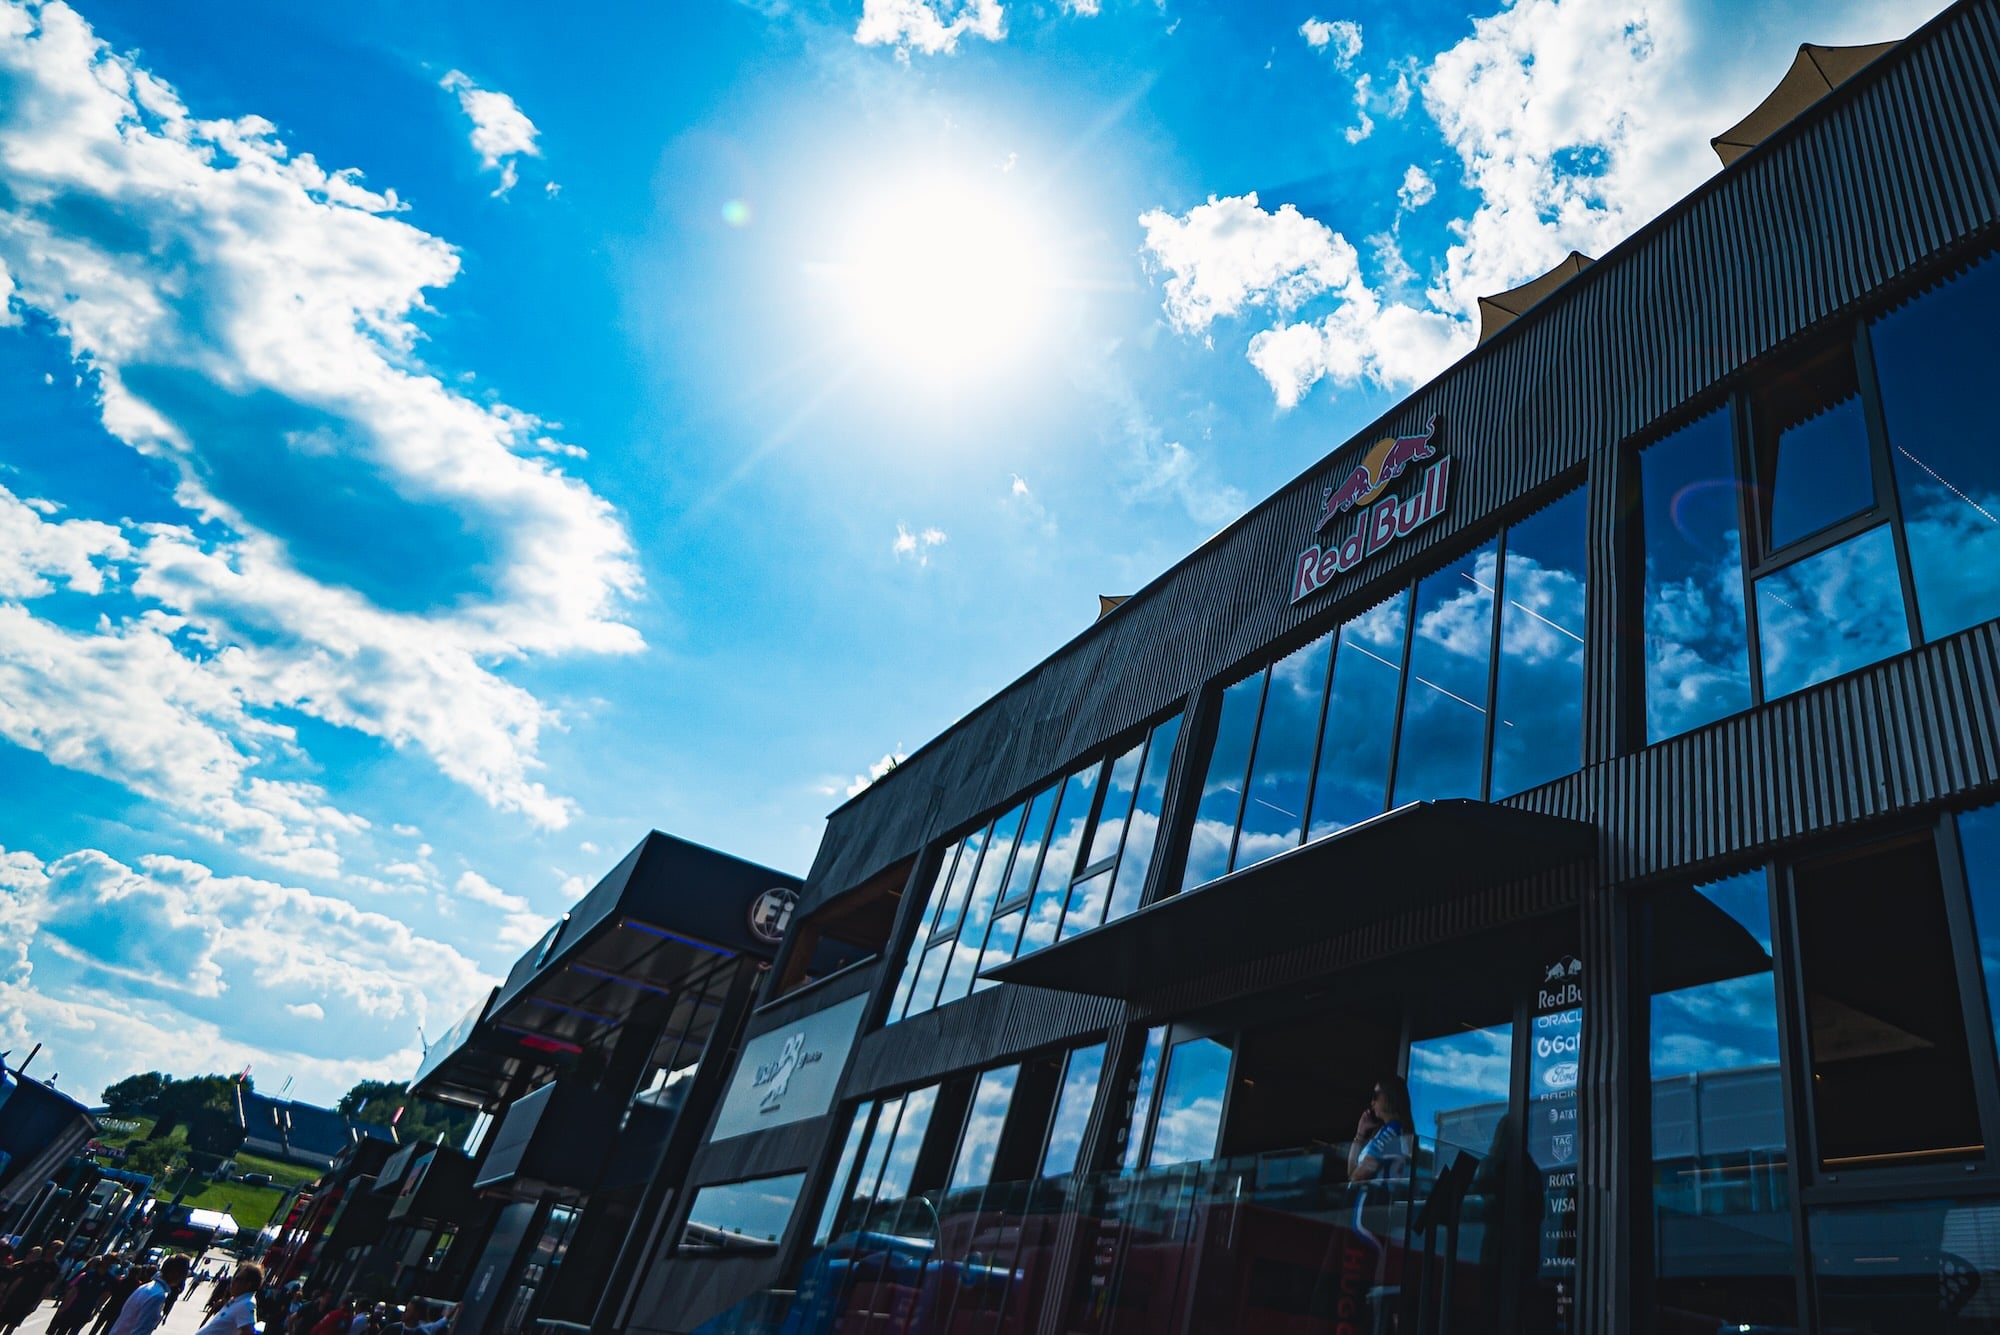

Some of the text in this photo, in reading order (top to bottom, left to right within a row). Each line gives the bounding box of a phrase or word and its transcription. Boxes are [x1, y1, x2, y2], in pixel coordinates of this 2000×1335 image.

[1291, 456, 1450, 604] Red Bull
[1538, 984, 1566, 1009] Red
[1555, 1137, 1571, 1145] TAG
[1550, 1197, 1576, 1213] VISA
